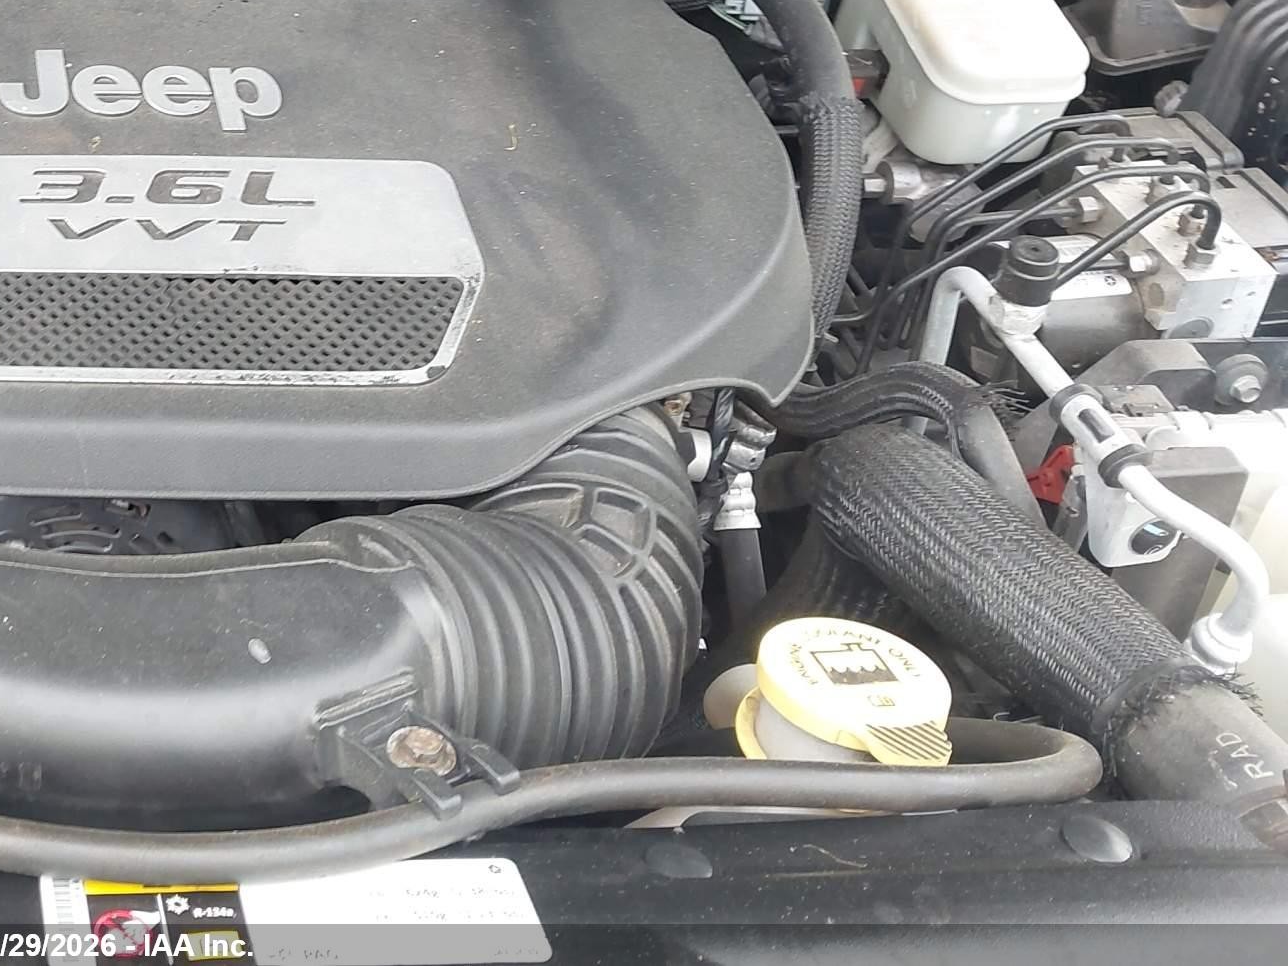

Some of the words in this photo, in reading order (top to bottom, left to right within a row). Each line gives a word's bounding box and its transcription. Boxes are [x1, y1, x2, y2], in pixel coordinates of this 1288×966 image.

[19, 170, 316, 205] 3.6L
[47, 218, 288, 242] VVT
[1216, 733, 1274, 779] RAD
